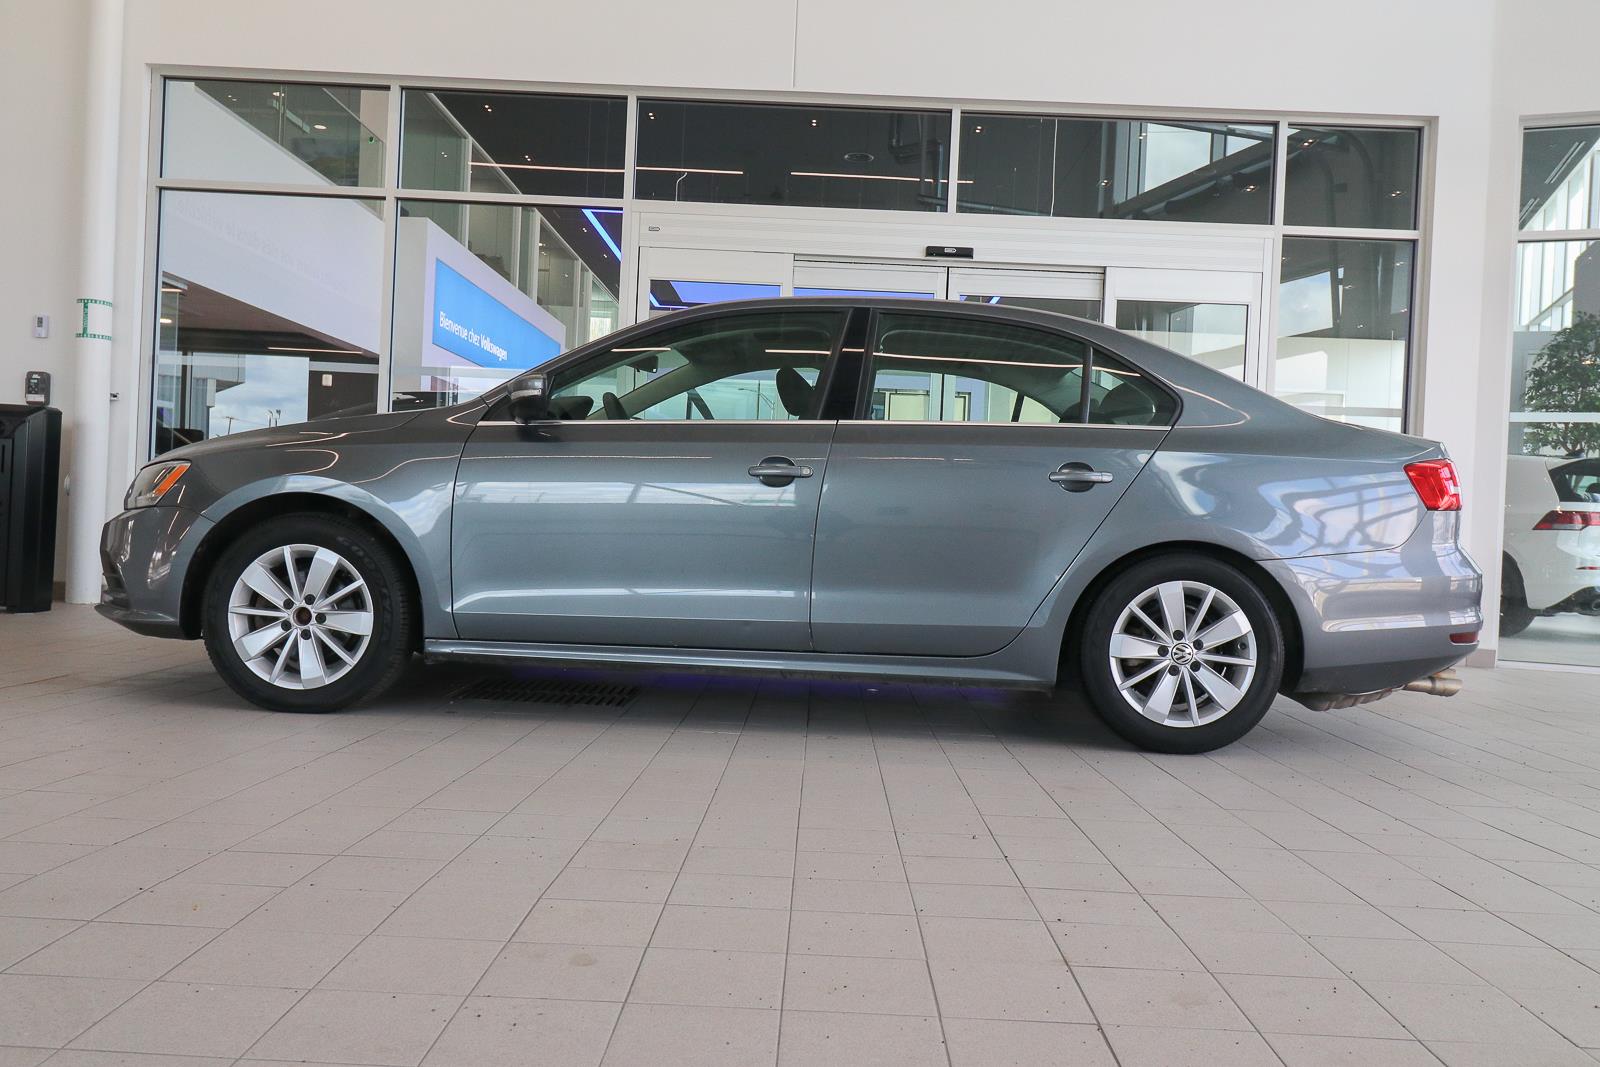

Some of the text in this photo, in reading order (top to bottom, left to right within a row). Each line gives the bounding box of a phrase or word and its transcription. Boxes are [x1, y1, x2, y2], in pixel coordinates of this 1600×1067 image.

[440, 311, 508, 361] Bienvenue chez Volkswagen
